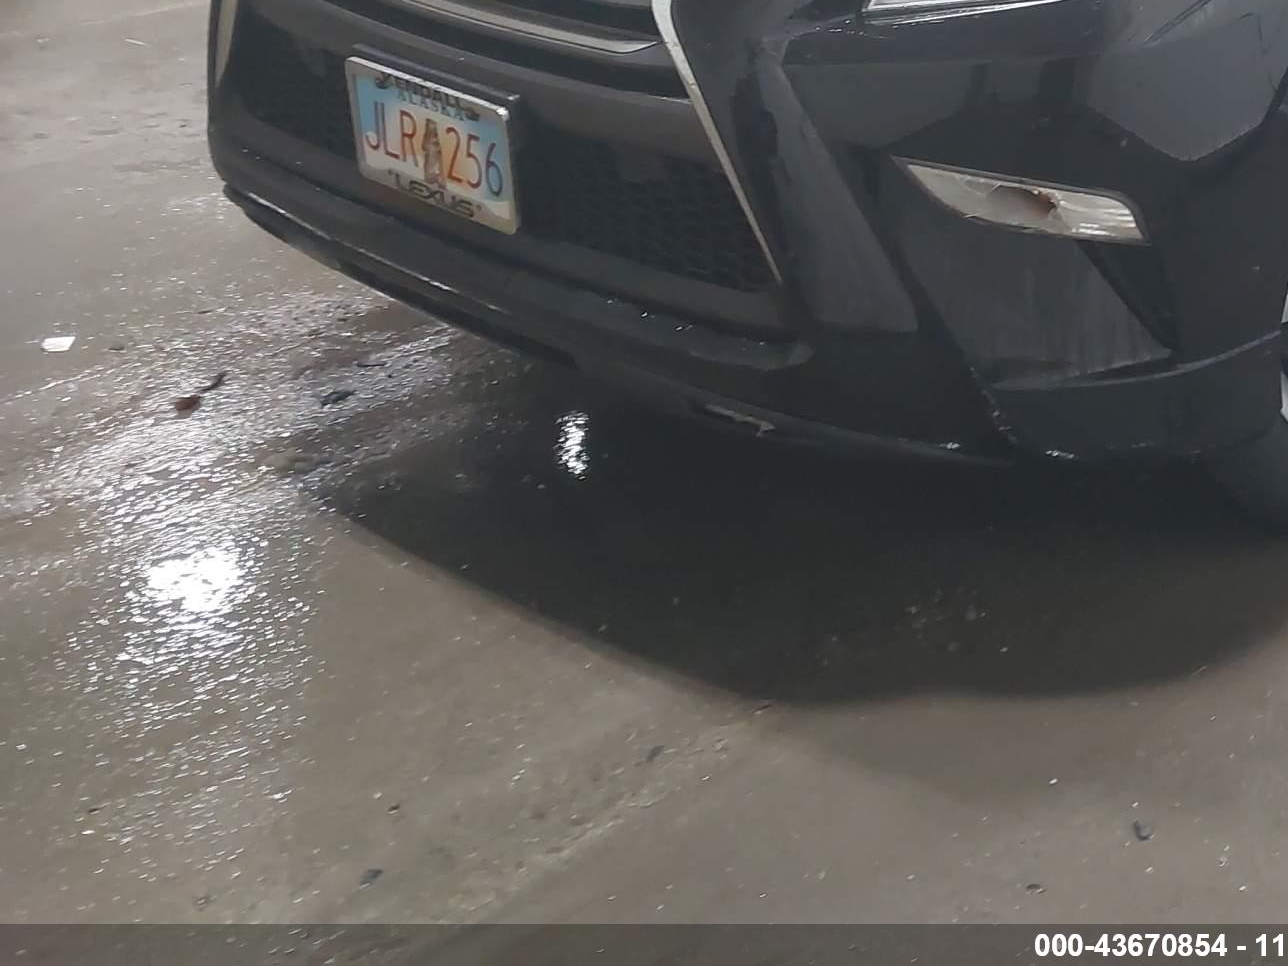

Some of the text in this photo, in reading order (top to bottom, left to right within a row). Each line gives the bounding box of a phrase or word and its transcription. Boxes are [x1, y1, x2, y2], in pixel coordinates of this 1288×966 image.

[396, 89, 466, 122] ALASKA
[445, 126, 504, 197] 256
[394, 172, 476, 218] LEXUS
